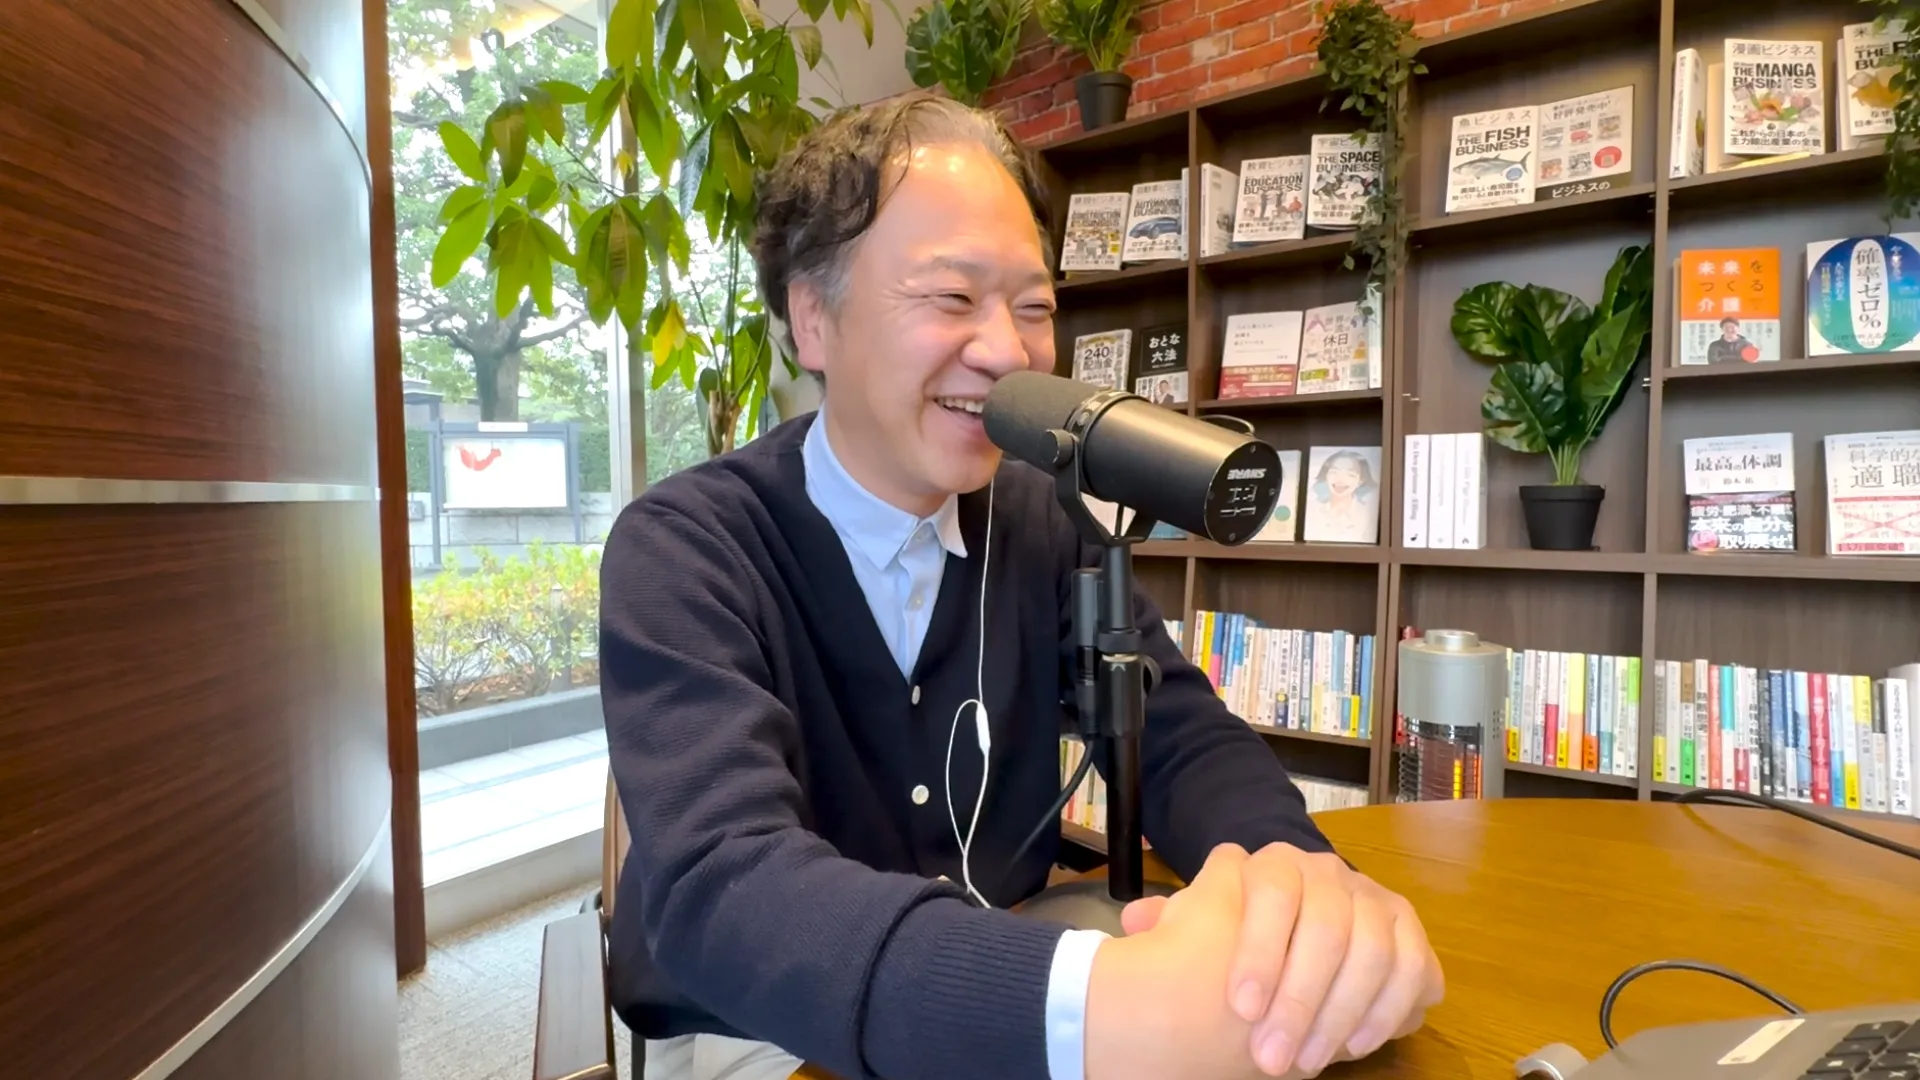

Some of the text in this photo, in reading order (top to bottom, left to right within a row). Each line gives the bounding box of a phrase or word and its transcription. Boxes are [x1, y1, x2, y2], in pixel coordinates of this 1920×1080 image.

[1732, 42, 1817, 56] 漫画ビジネス
[1854, 47, 1889, 59] THE
[1733, 62, 1816, 77] THE MANGA
[1458, 109, 1532, 128] 魚ビジネス
[1317, 135, 1379, 147] 宇宙ビス
[1457, 125, 1531, 146] THE FISH
[1455, 138, 1529, 156] BUSINESS
[1316, 151, 1381, 163] THE SPACE
[1244, 173, 1303, 187] EDUCATION
[1243, 184, 1302, 195] BUSINESS
[1552, 181, 1611, 199] ビジネスの
[1697, 259, 1765, 277] 未来を
[1699, 279, 1765, 292] つくる
[1856, 247, 1882, 329] 確率ゼロ%
[1697, 296, 1741, 313] 介護
[1148, 333, 1181, 349] おとな
[1323, 333, 1349, 347] 休日
[1084, 346, 1110, 360] 240
[1083, 357, 1113, 371] 配当金
[1694, 453, 1783, 472] 最高の体調
[1227, 468, 1267, 480] SHURE
[1850, 463, 1920, 489] 適職
[1690, 515, 1794, 533] 本来の自分を
